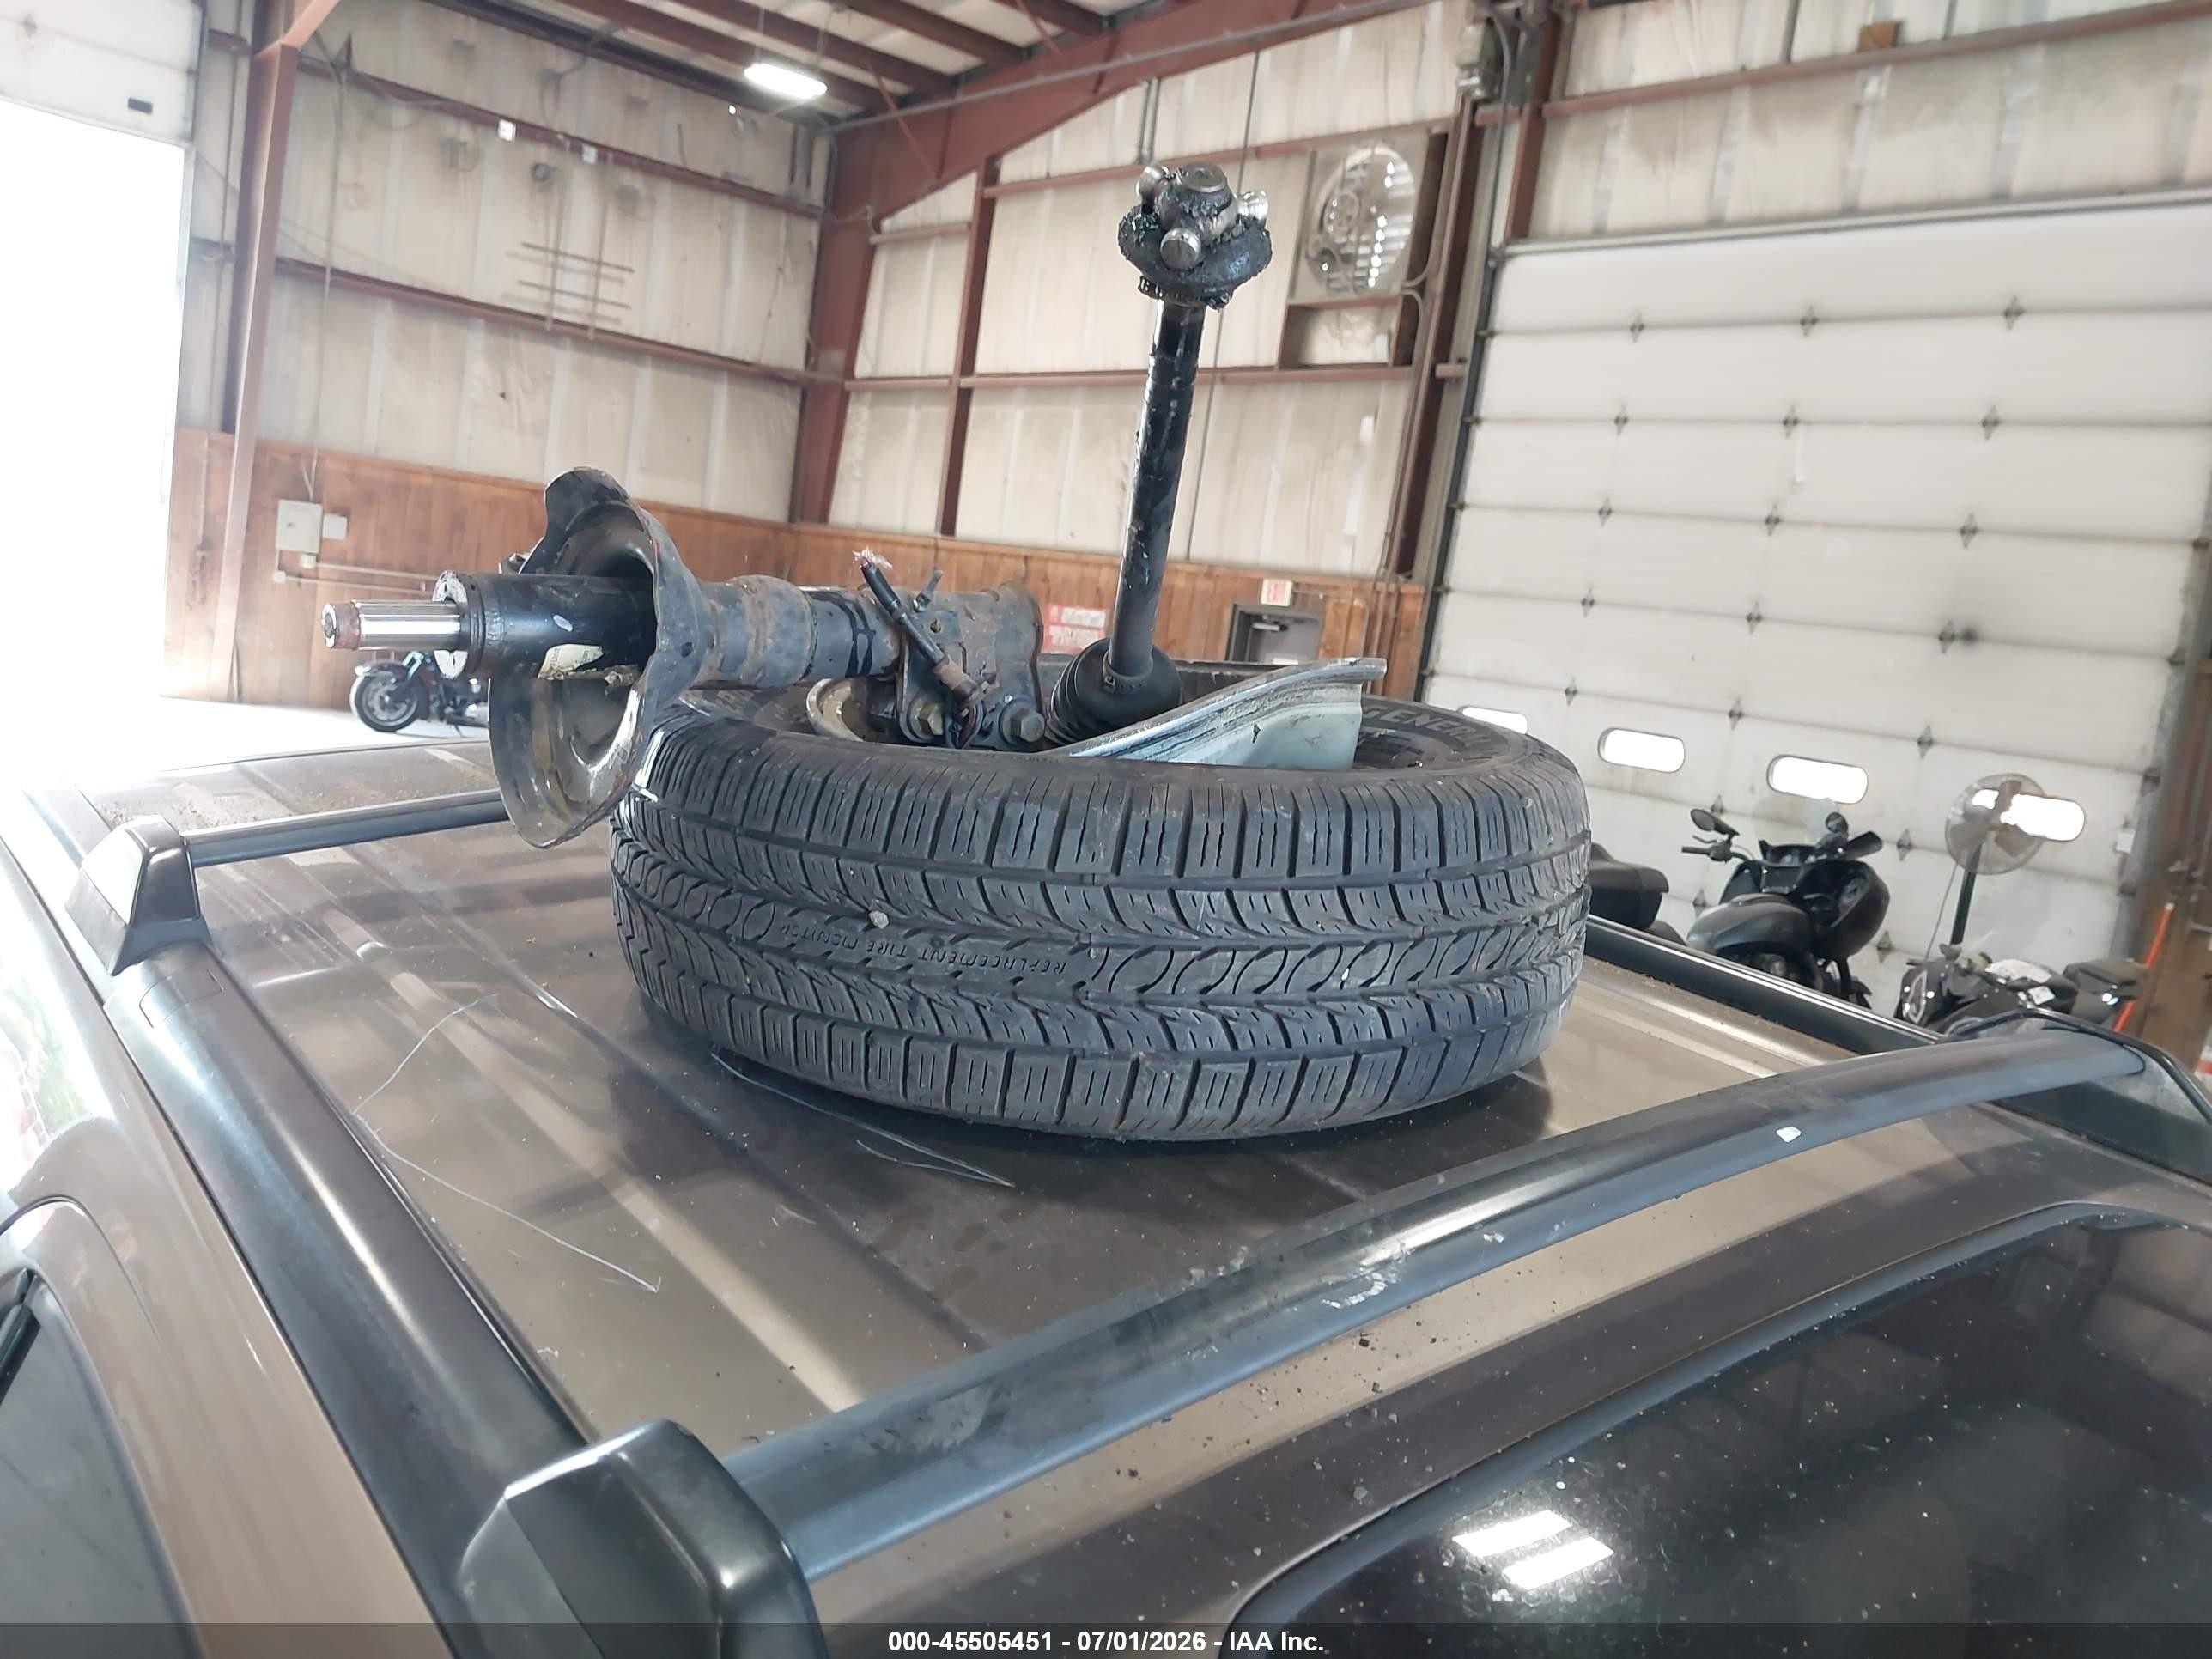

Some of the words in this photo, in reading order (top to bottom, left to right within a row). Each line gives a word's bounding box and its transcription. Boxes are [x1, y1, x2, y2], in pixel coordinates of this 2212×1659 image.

[780, 923, 859, 949] MONITOR
[866, 939, 908, 958] TIRE
[917, 947, 1067, 975] REPLACEMENT
